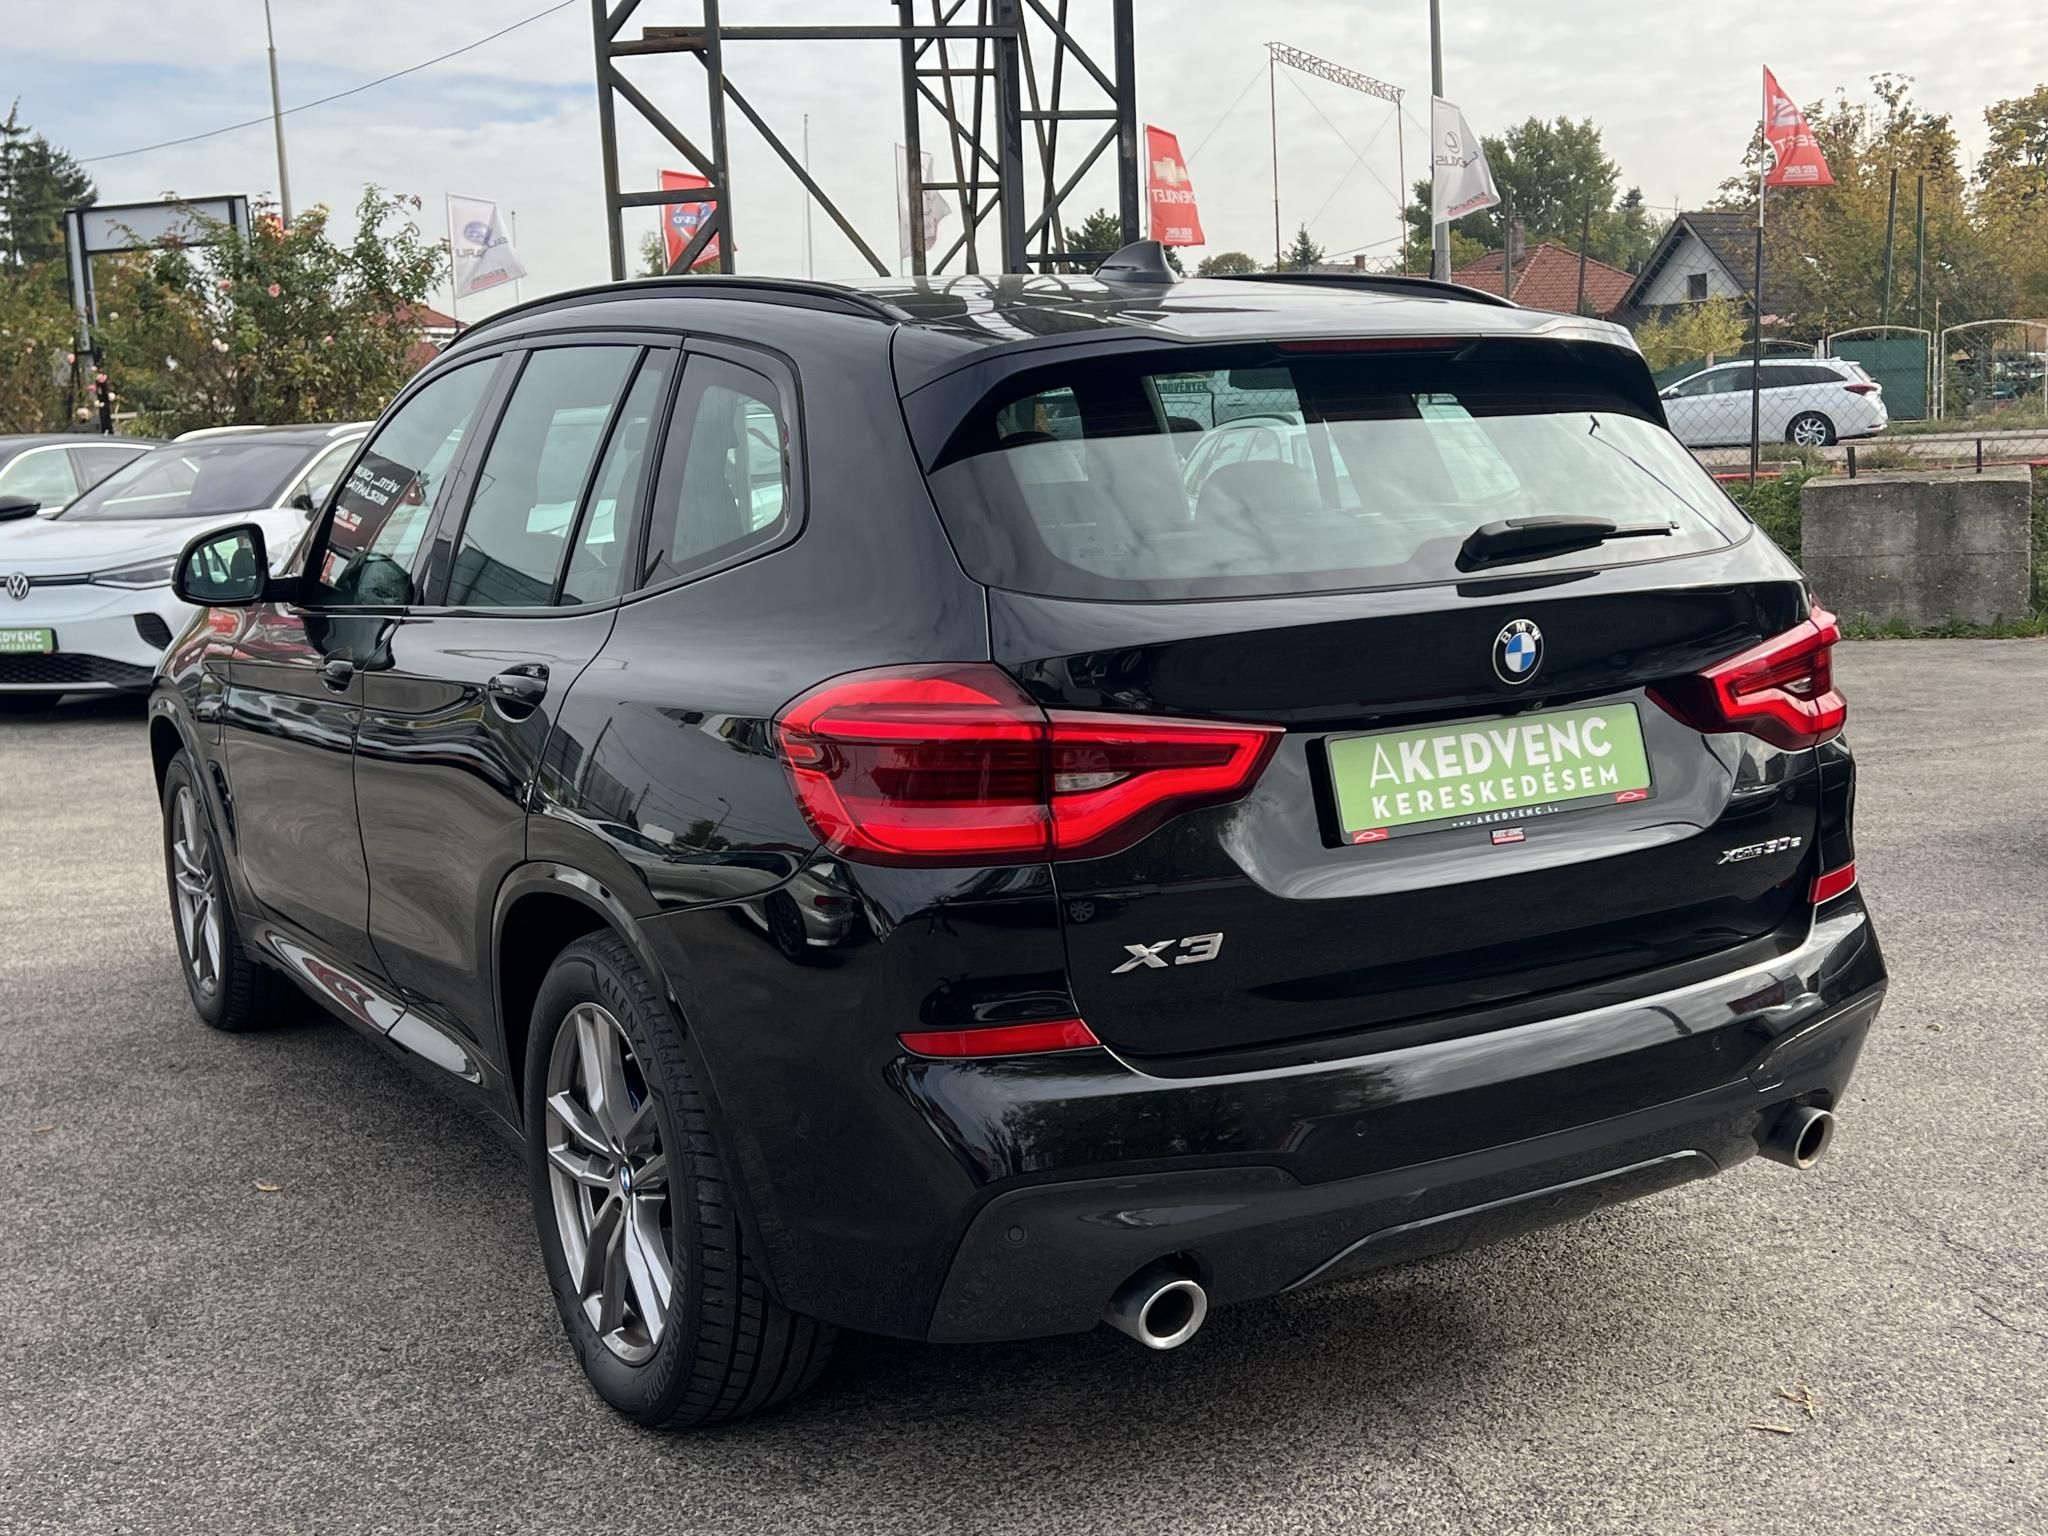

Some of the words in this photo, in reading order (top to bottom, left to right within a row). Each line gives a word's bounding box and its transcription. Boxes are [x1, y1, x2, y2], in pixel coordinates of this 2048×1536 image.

[0, 631, 42, 643] DVENC
[1500, 622, 1541, 644] BMW
[1372, 763, 1618, 819] KERESKEDÉSEM
[1110, 932, 1223, 974] X3
[601, 977, 653, 1073] ALENZA
